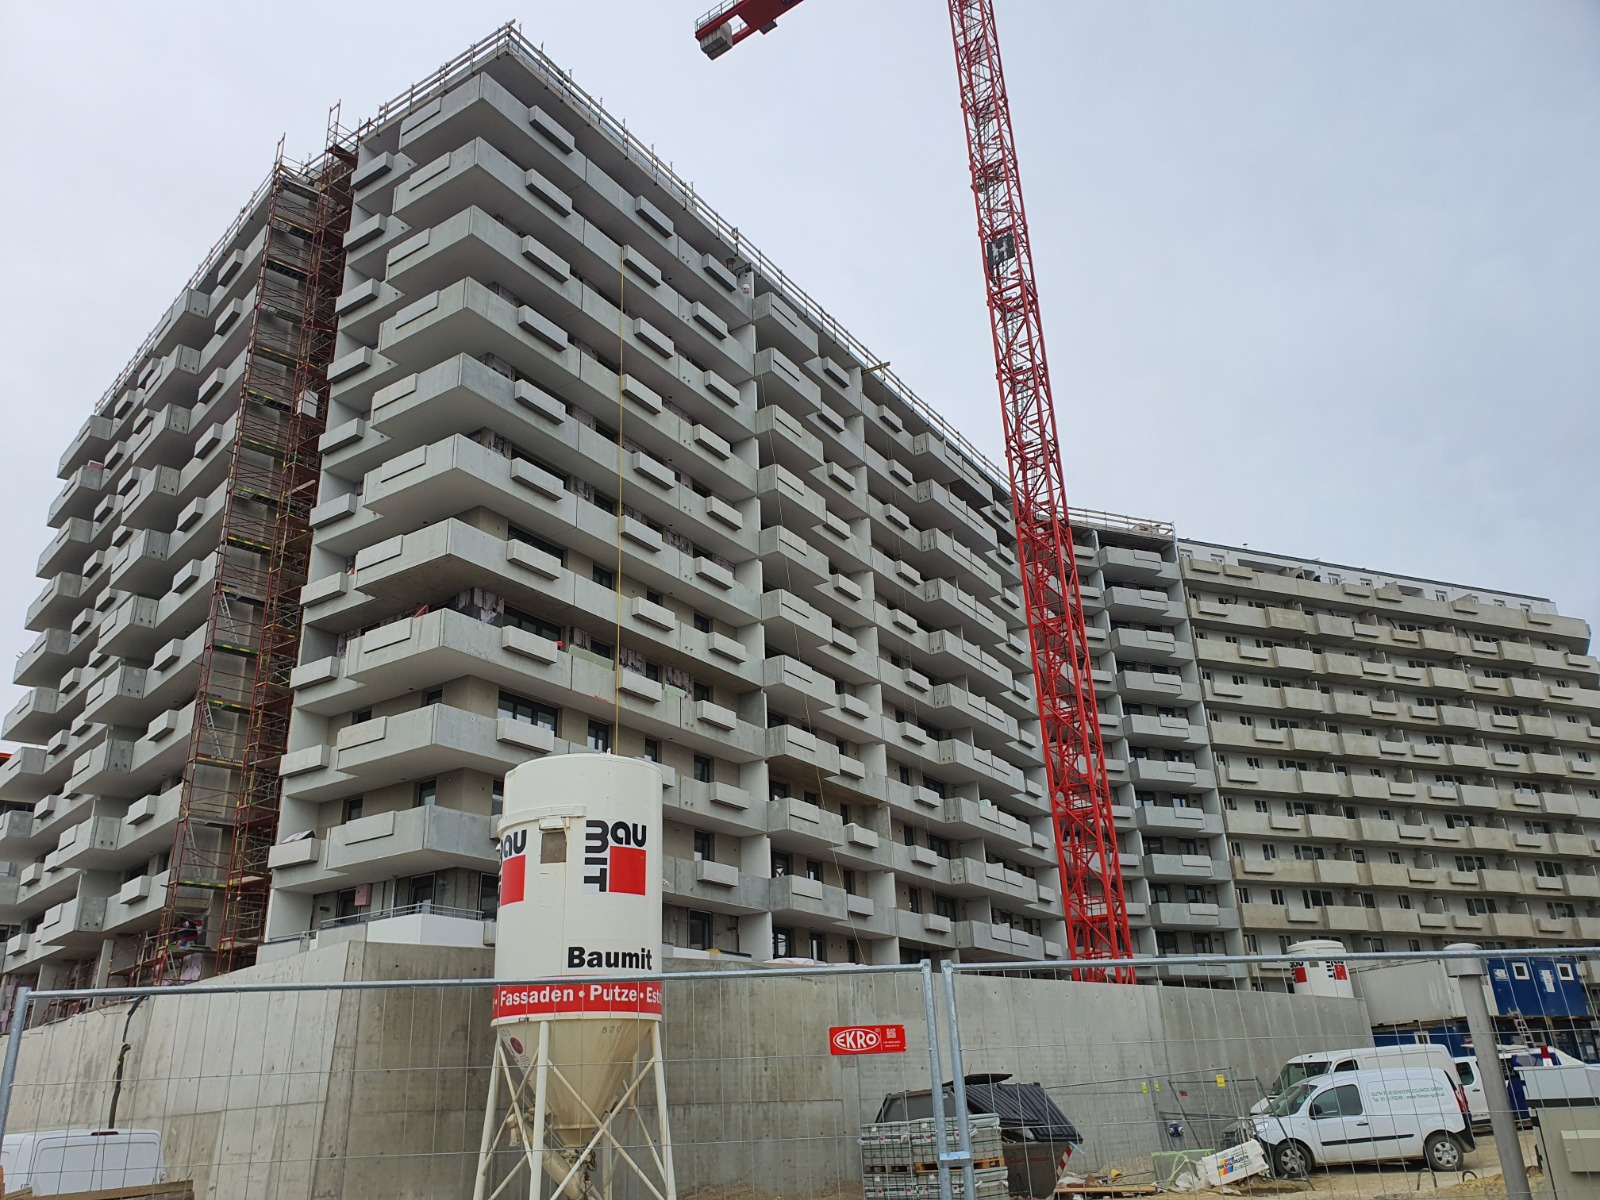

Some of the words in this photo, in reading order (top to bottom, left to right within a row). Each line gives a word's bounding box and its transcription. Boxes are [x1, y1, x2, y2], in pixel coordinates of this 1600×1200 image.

[568, 947, 652, 970] Baumit
[500, 986, 574, 1007] Fassaden
[590, 985, 637, 1002] Putze
[836, 1030, 877, 1049] EKRO
